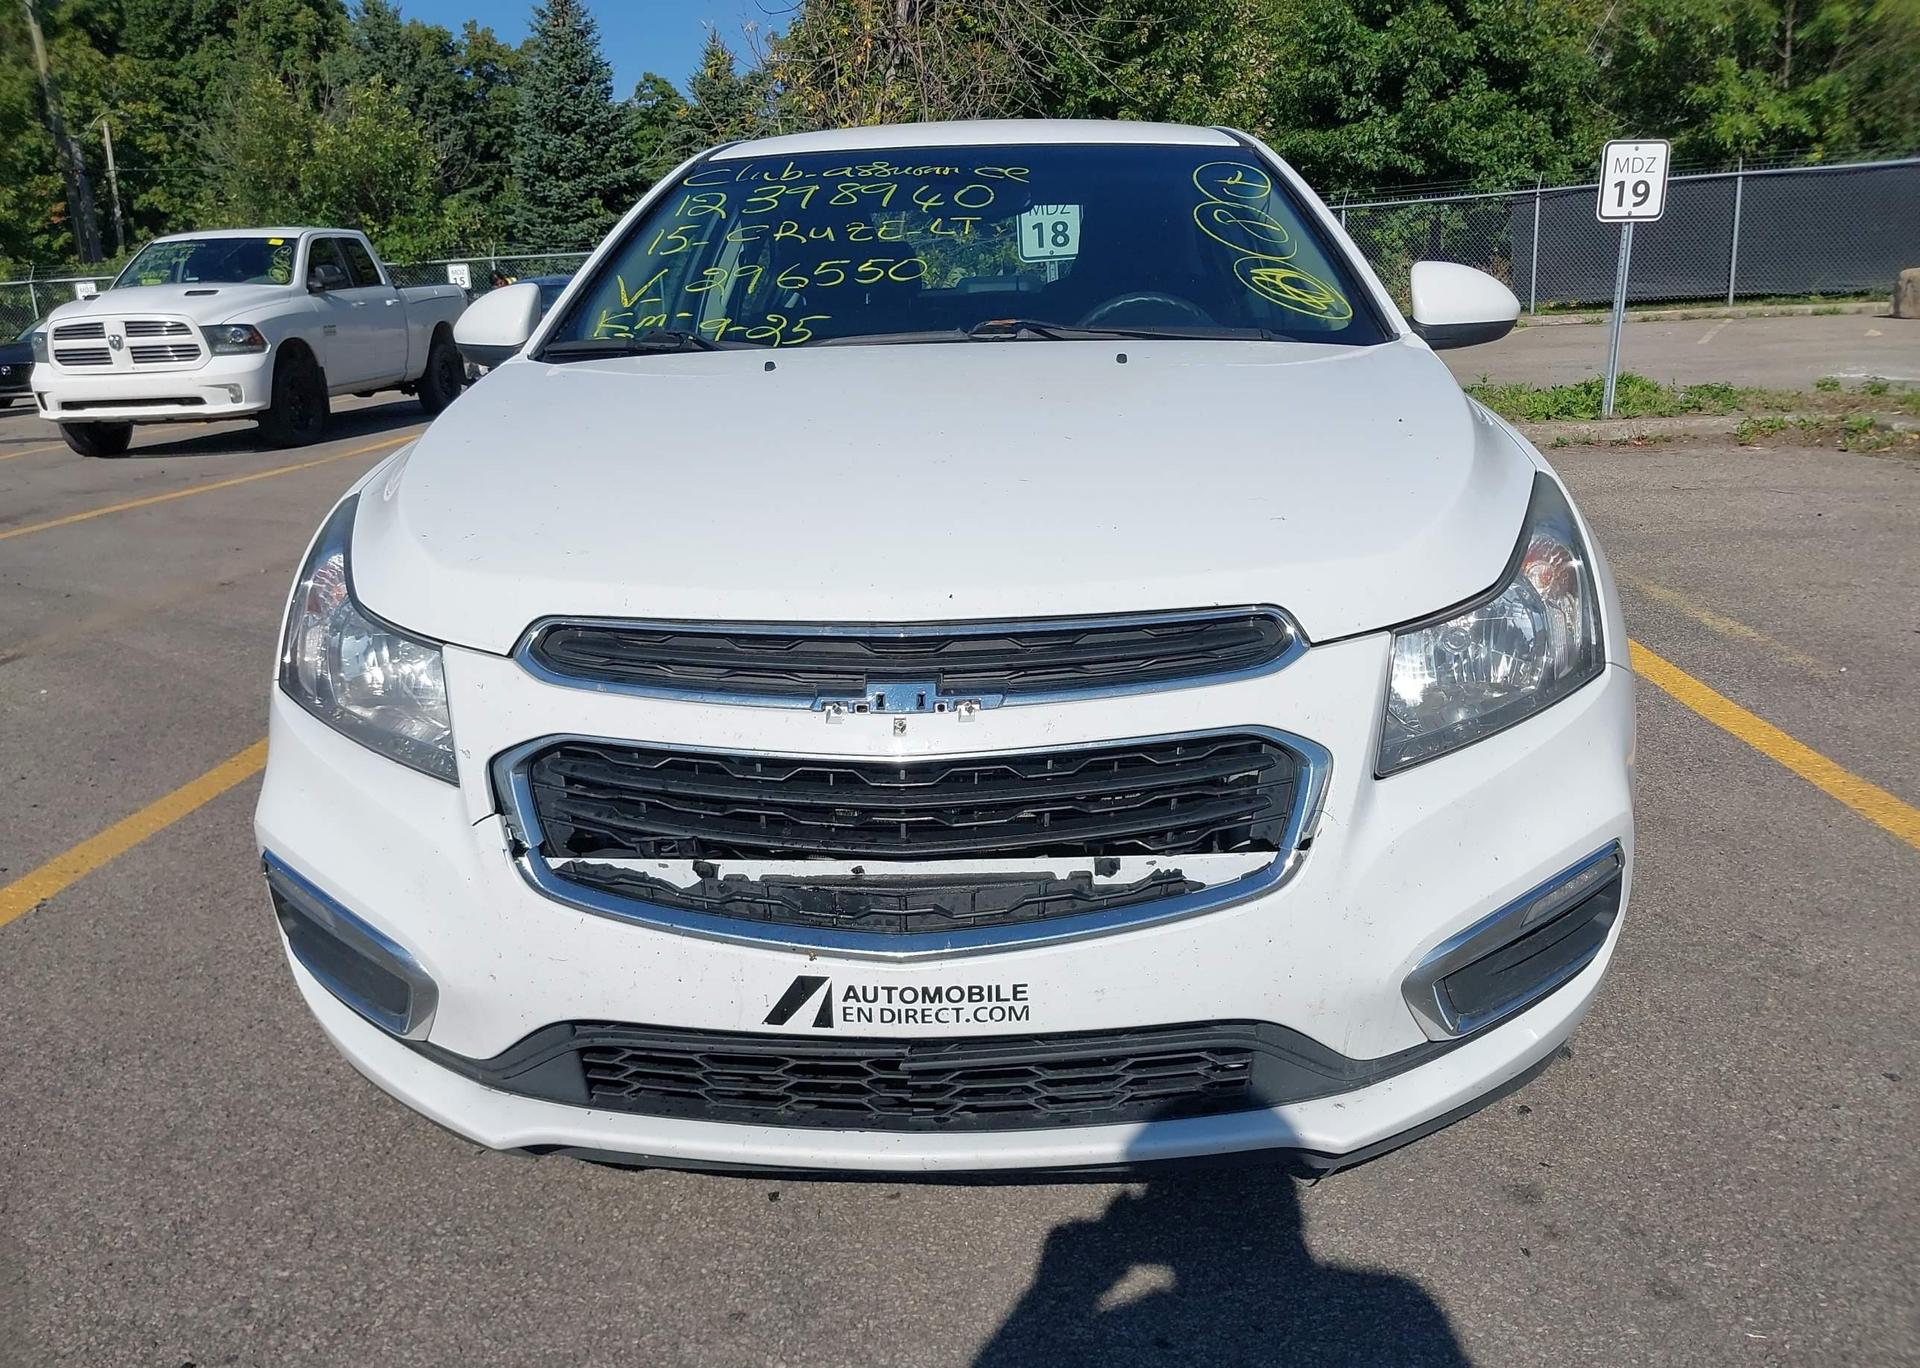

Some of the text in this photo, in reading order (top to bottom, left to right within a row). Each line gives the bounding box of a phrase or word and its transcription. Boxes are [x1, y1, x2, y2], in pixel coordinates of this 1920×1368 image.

[1613, 157, 1657, 174] MDZ
[1613, 180, 1651, 208] 19
[1032, 221, 1070, 249] 18
[842, 983, 1029, 1005] AUTOMOBILE
[842, 1004, 1030, 1025] EN DIRECT.COM
